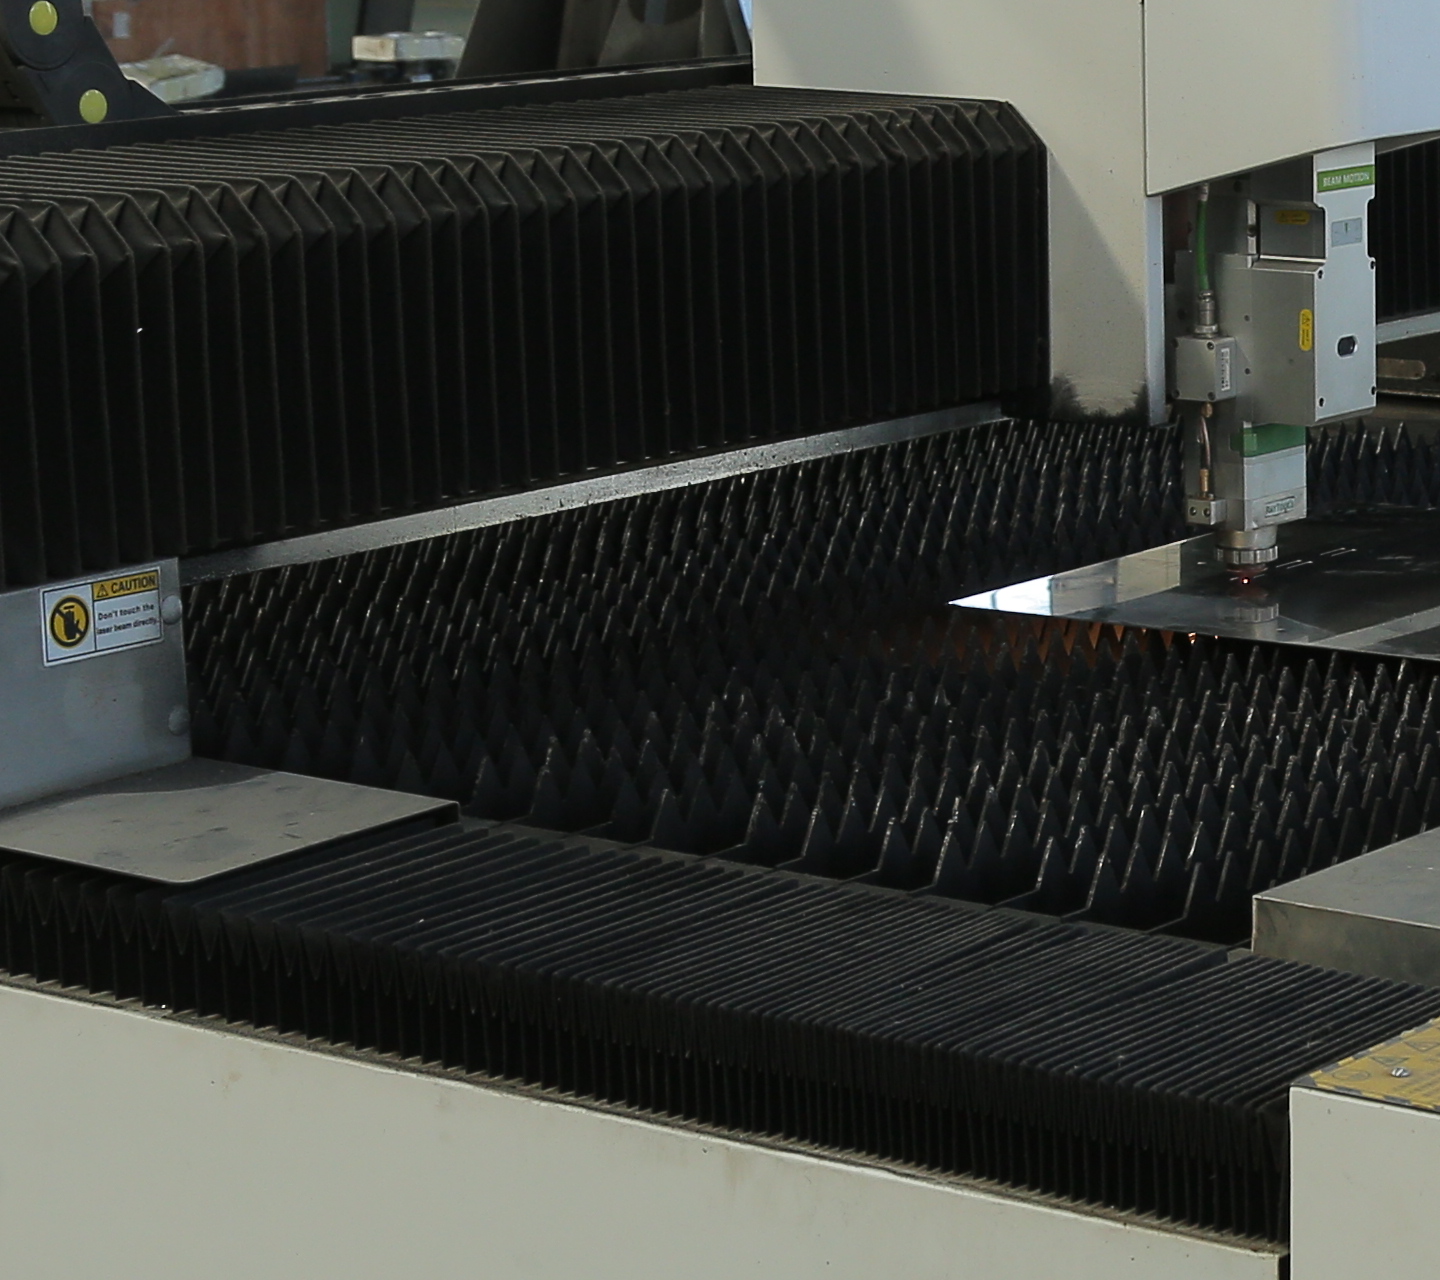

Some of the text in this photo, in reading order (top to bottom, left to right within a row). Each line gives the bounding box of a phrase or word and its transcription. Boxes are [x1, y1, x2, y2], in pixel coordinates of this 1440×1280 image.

[1322, 176, 1341, 187] BEAM
[111, 576, 156, 593] CAUTION
[98, 602, 155, 620] Don't touch the
[115, 623, 132, 631] beam
